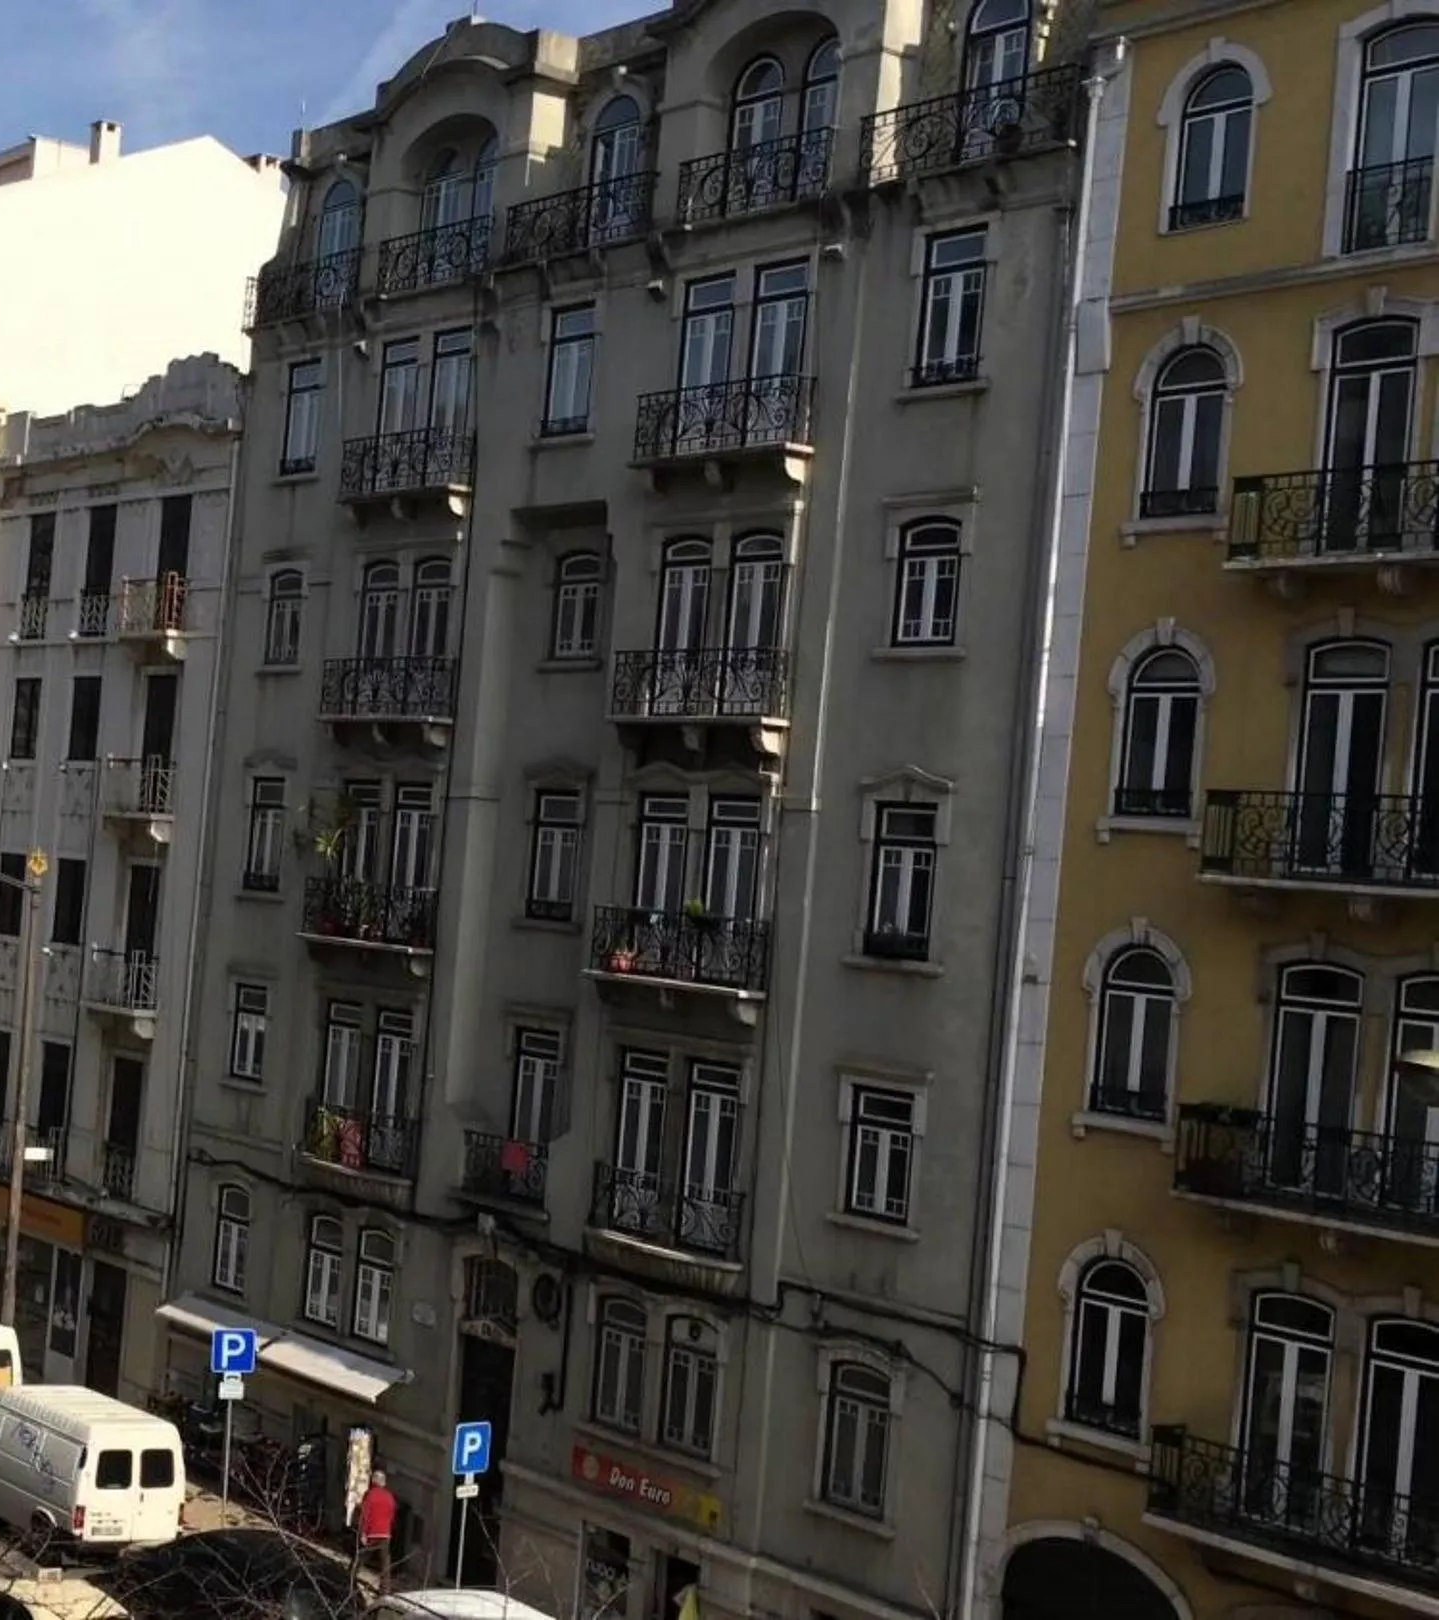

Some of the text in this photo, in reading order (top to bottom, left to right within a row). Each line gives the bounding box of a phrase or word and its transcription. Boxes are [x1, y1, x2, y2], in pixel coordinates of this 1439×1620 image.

[221, 1333, 246, 1369] P
[462, 1432, 482, 1466] P
[610, 1466, 672, 1505] Don Euro
